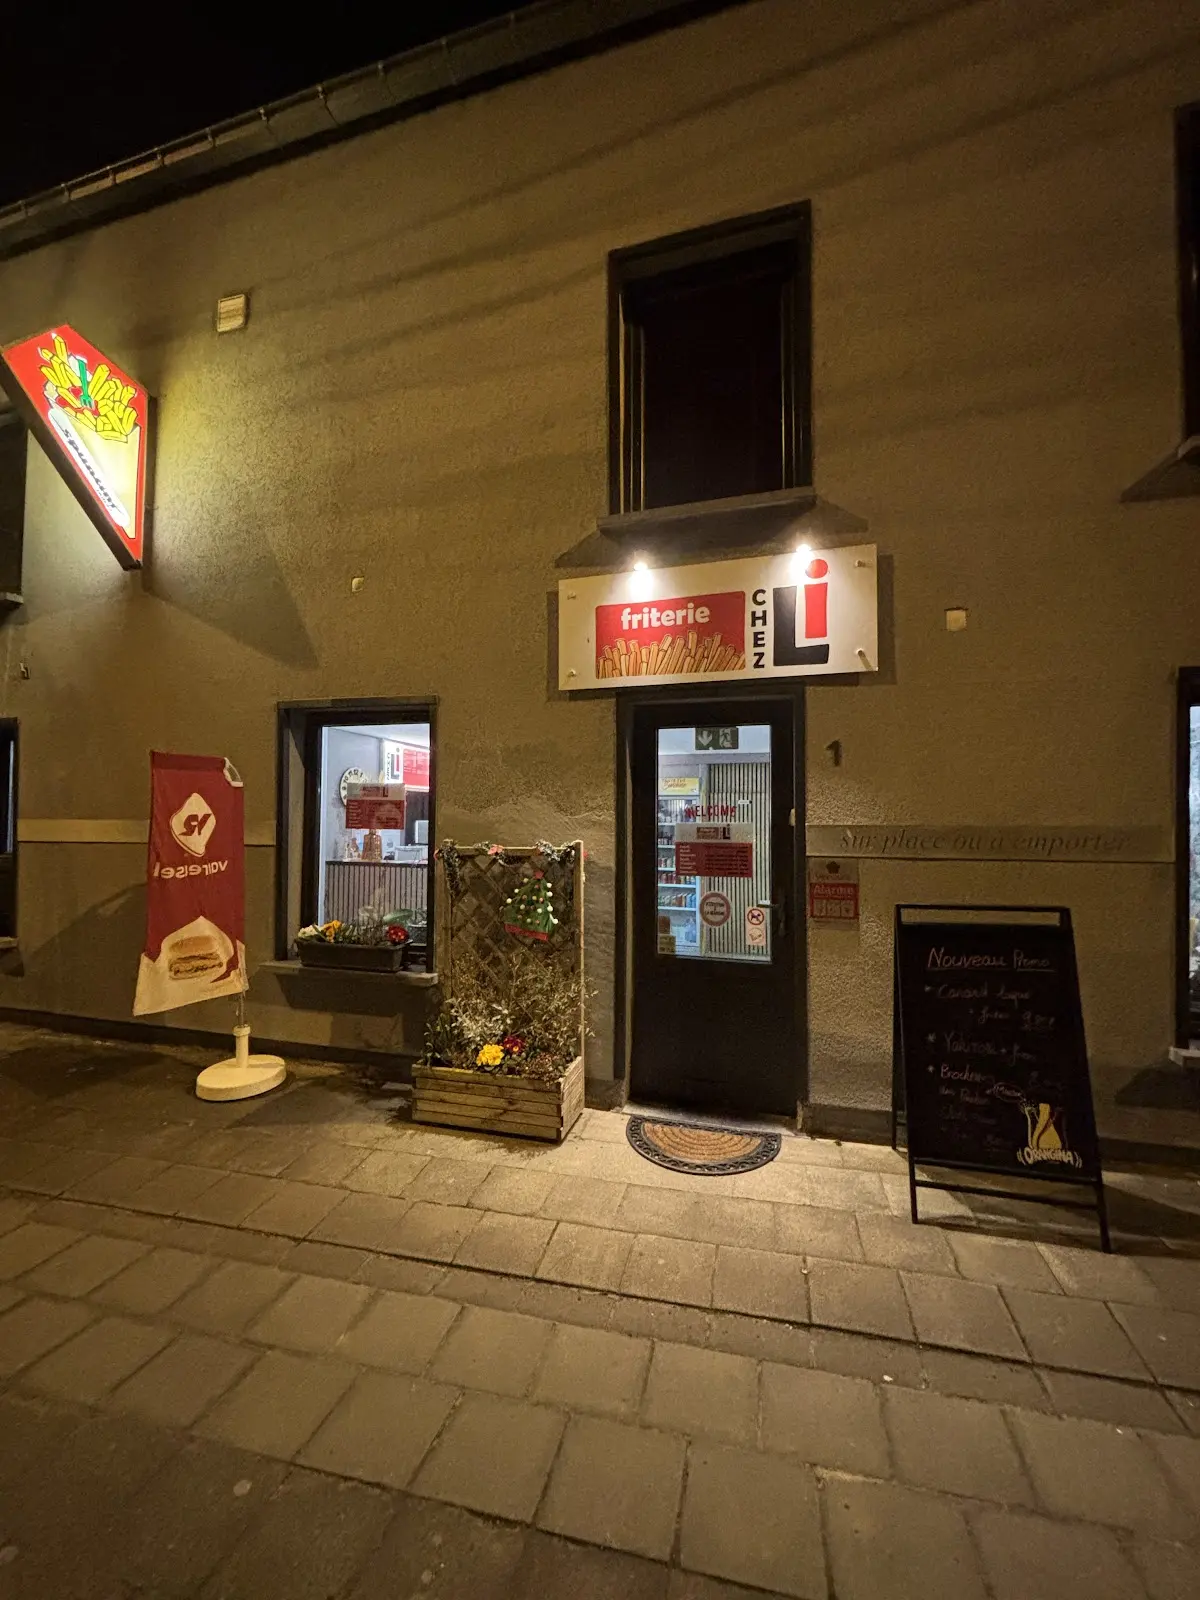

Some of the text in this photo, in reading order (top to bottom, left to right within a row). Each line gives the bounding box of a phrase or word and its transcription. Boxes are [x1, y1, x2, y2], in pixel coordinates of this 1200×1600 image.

[621, 602, 711, 630] friterie
[750, 558, 829, 669] CHEZ Li
[684, 804, 737, 819] WELCOME
[840, 834, 876, 849] sur
[881, 828, 944, 853] place
[953, 834, 982, 850] ou
[1012, 834, 1132, 857] emporter
[927, 945, 1008, 969] Nouveau
